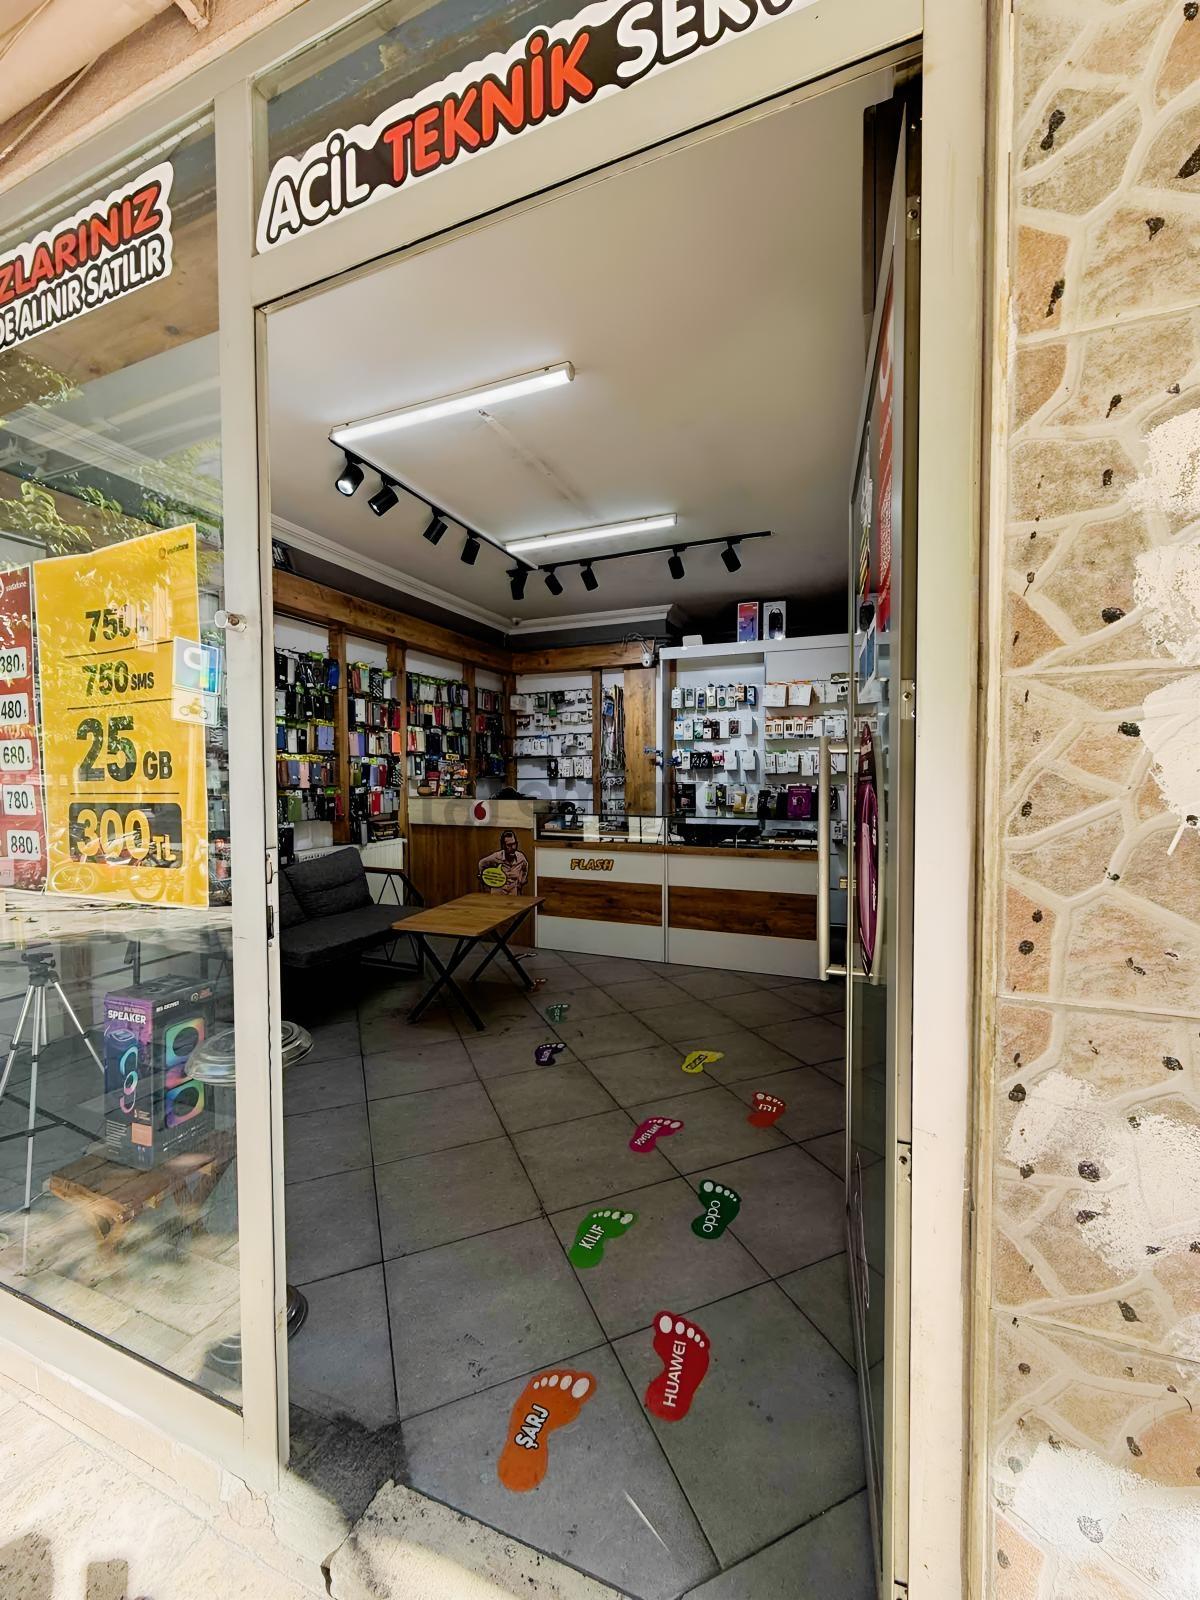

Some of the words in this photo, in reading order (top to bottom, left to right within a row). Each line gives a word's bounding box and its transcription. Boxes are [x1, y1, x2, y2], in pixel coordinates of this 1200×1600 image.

[18, 278, 82, 338] ALINIR
[84, 238, 163, 303] SATILIR
[82, 660, 129, 697] 750
[130, 672, 155, 691] SMS
[76, 715, 137, 783] 25
[142, 750, 173, 781] GB
[76, 808, 151, 861] 300
[151, 834, 177, 862] TL
[570, 858, 615, 872] FLASH
[107, 1009, 147, 1025] SPEAKER
[578, 1223, 605, 1250] KILIF
[662, 1340, 687, 1408] HUAWEI
[514, 1402, 550, 1449] ŞARJ
